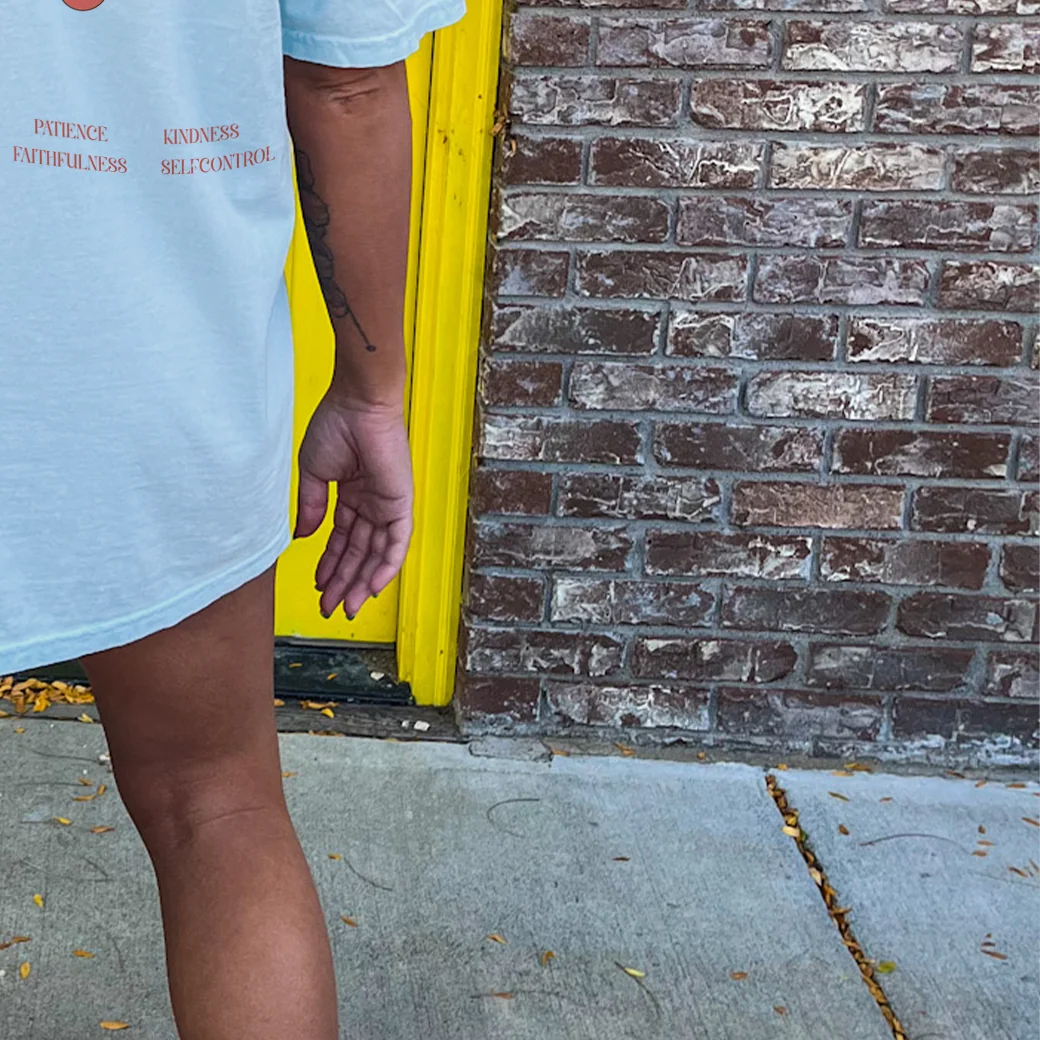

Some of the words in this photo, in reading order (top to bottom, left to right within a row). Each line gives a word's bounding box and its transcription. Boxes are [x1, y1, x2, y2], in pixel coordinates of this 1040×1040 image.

[33, 118, 108, 143] PATIENCE
[163, 123, 240, 145] KINDNESS
[13, 146, 128, 174] FAITHFULNESS
[161, 146, 276, 175] SELFCONTROL
